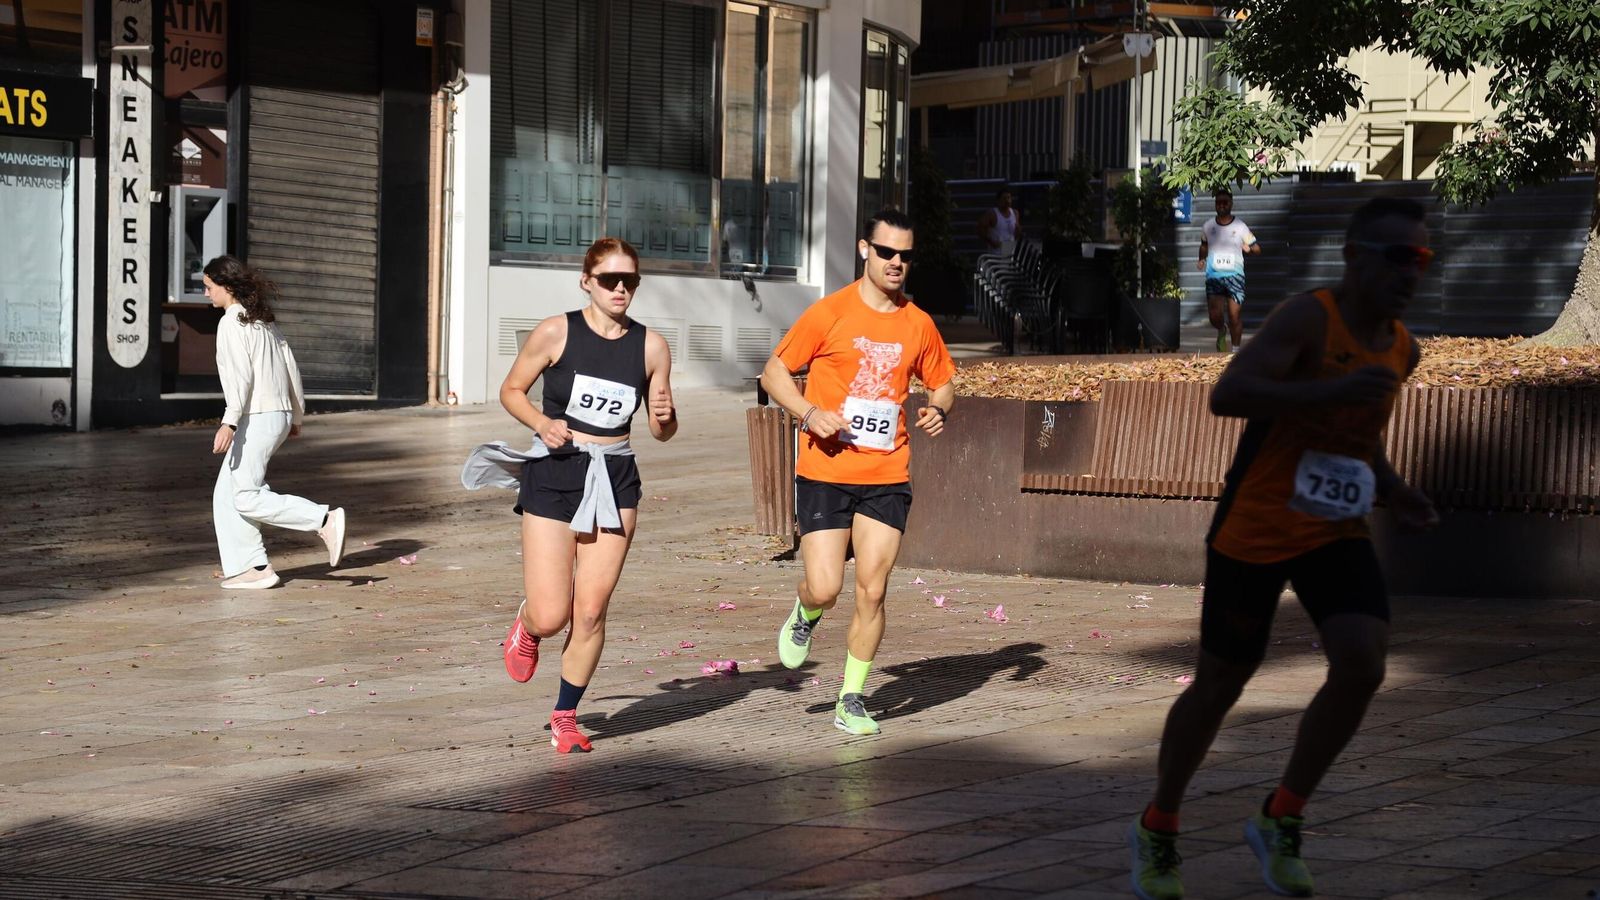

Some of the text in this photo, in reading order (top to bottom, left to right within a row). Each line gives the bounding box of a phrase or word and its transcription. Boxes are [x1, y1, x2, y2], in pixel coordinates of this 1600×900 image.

[0, 152, 70, 169] MANAGEMENT
[121, 16, 139, 325] SNEAKERS
[117, 334, 140, 344] SHOP
[580, 393, 622, 415] 972
[851, 415, 890, 435] 952
[1307, 473, 1361, 504] 730
